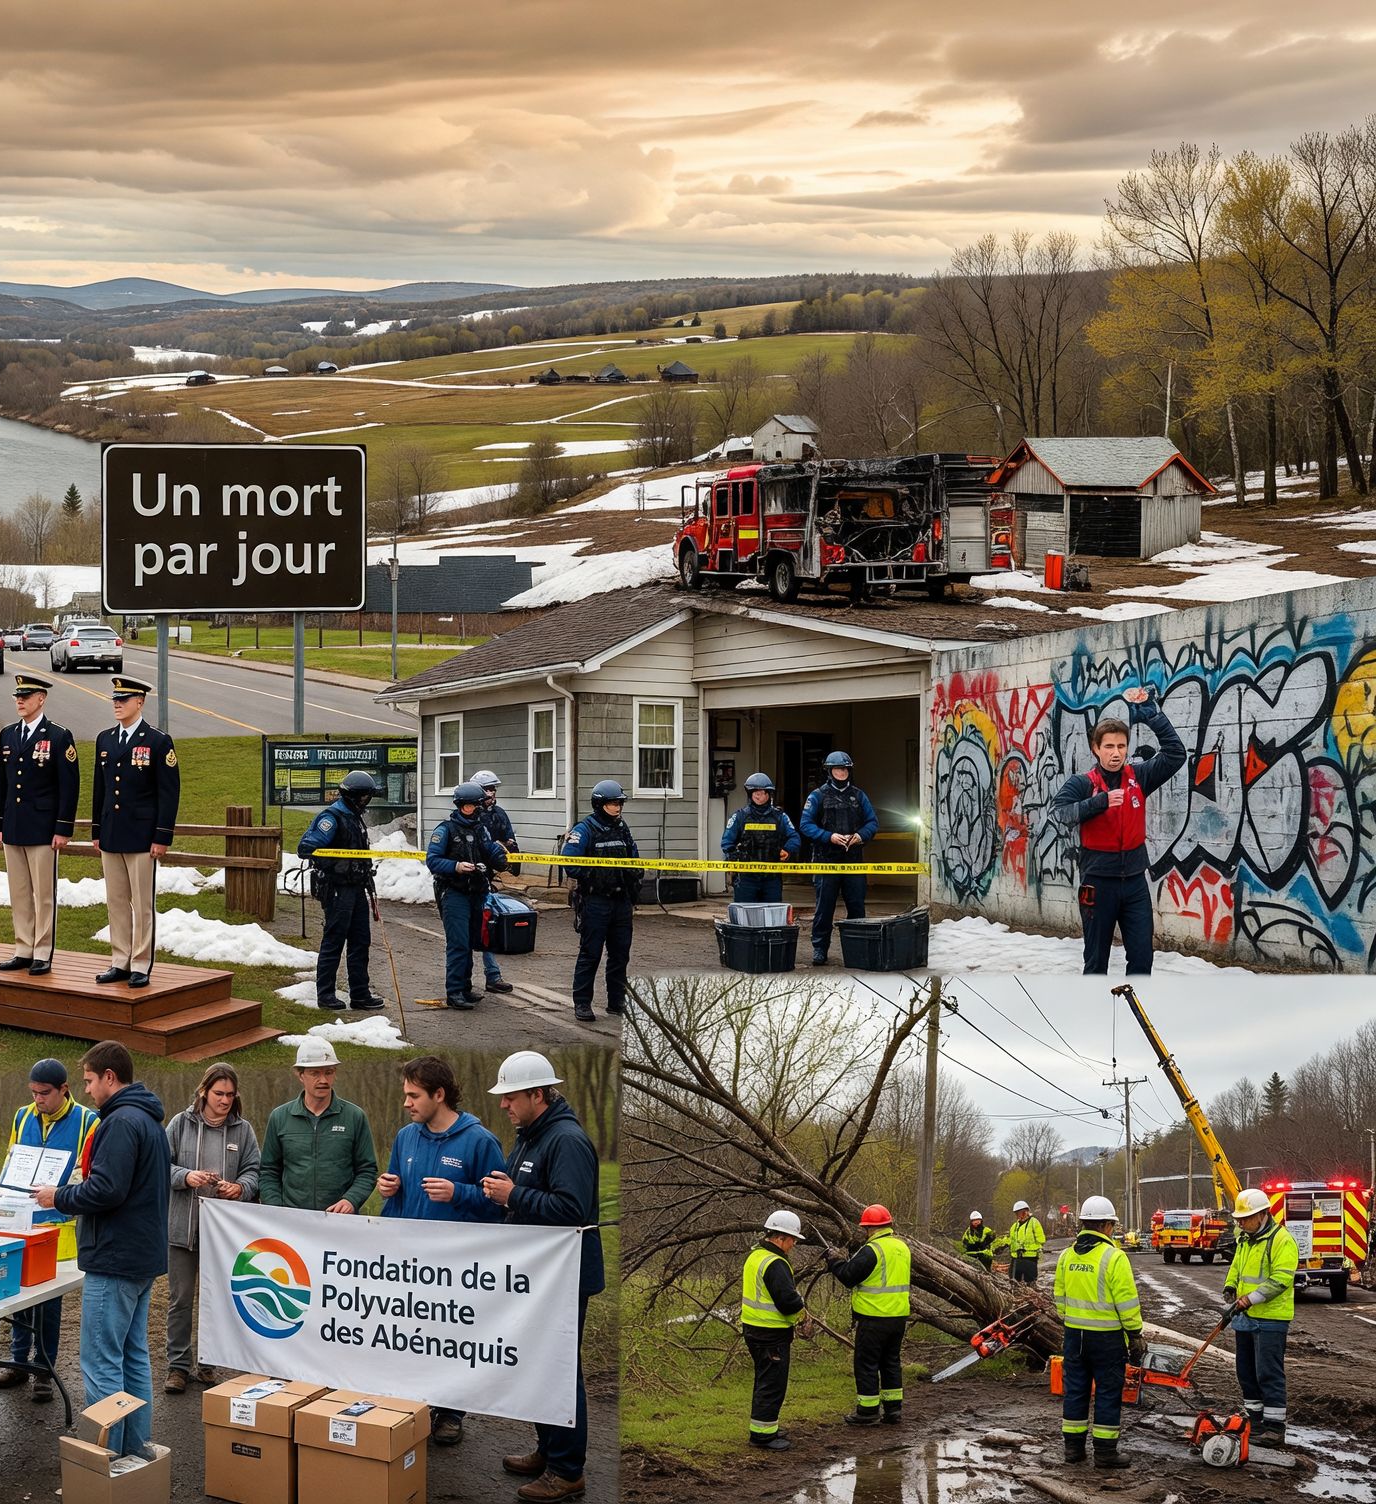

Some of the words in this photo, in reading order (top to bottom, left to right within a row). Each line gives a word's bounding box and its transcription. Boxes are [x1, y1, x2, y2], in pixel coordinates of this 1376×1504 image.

[132, 472, 201, 517] Un
[222, 476, 343, 517] mort
[134, 542, 218, 587] par
[231, 530, 336, 586] jour
[322, 1250, 452, 1287] Fondation
[460, 1261, 496, 1291] de
[505, 1264, 530, 1294] la
[321, 1284, 475, 1325] Polyvalente
[320, 1317, 364, 1346] des
[370, 1324, 519, 1369] Abénaquis
